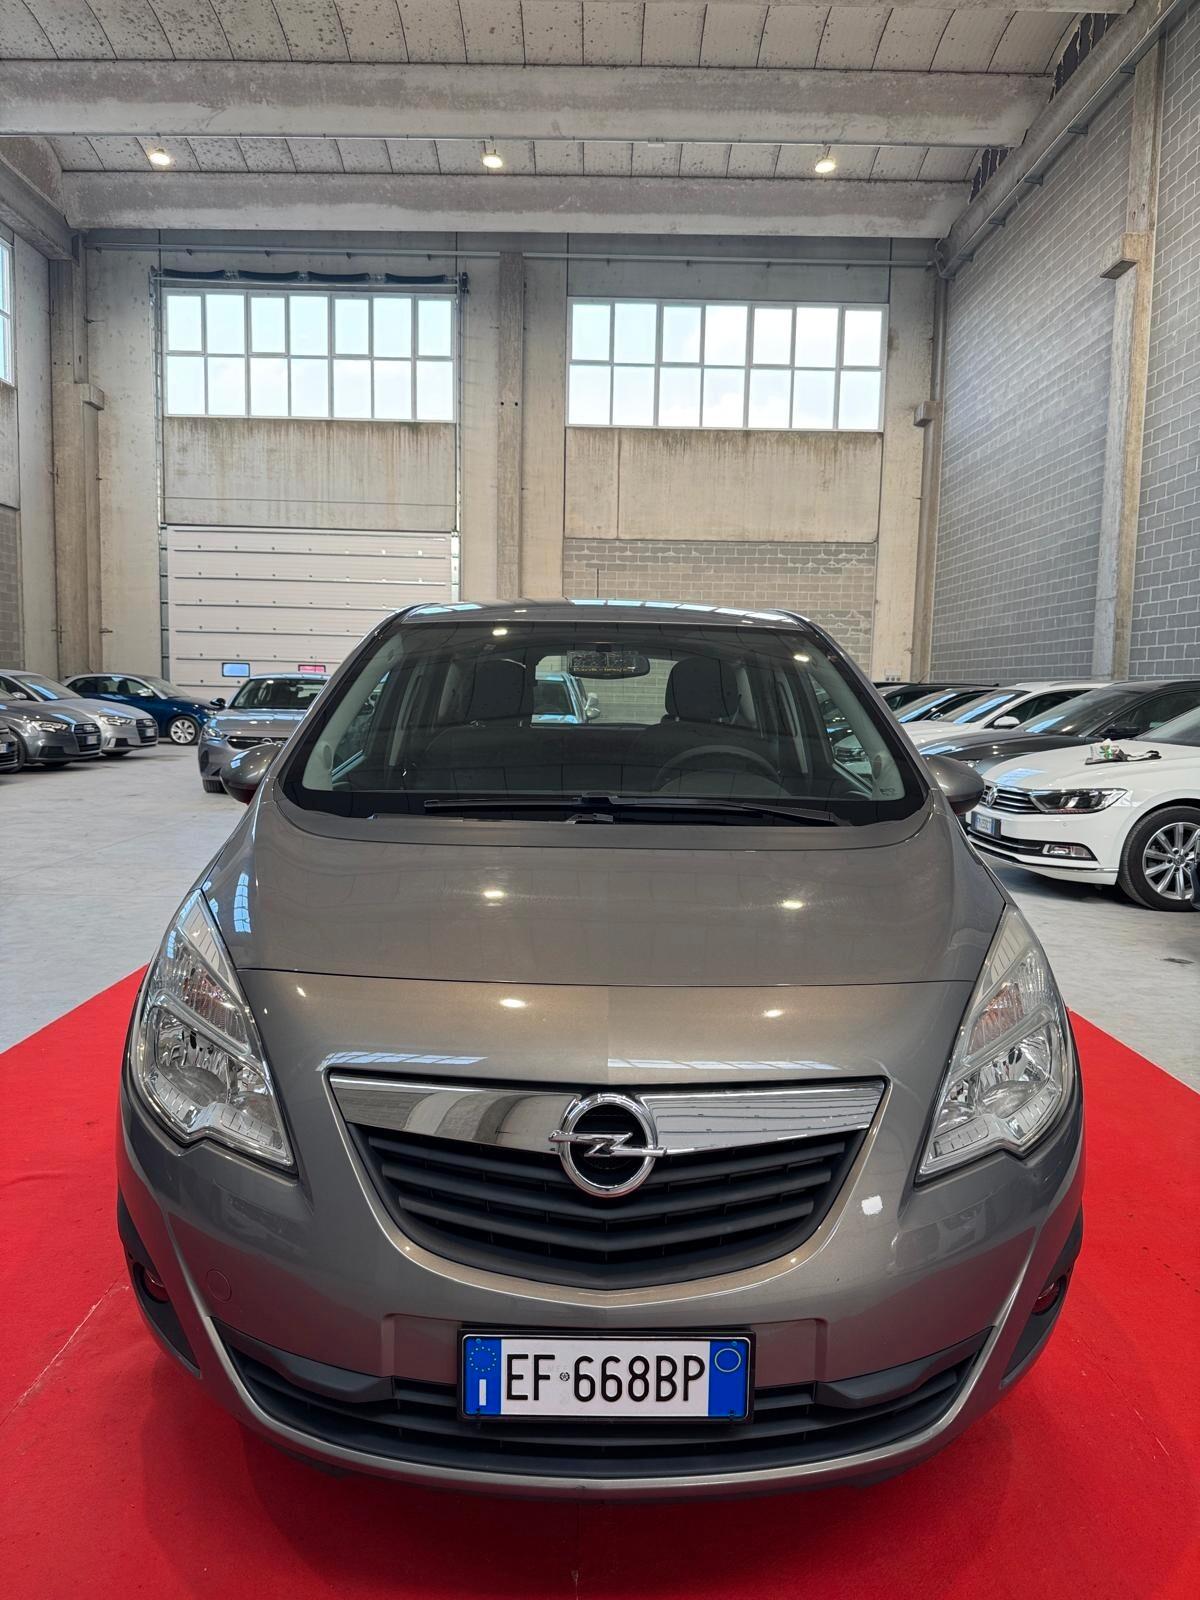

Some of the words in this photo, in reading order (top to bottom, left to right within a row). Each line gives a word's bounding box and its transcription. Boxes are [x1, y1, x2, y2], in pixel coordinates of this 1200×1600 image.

[478, 1378, 487, 1406] I
[506, 1353, 556, 1401] EF
[573, 1354, 706, 1403] 668BP
